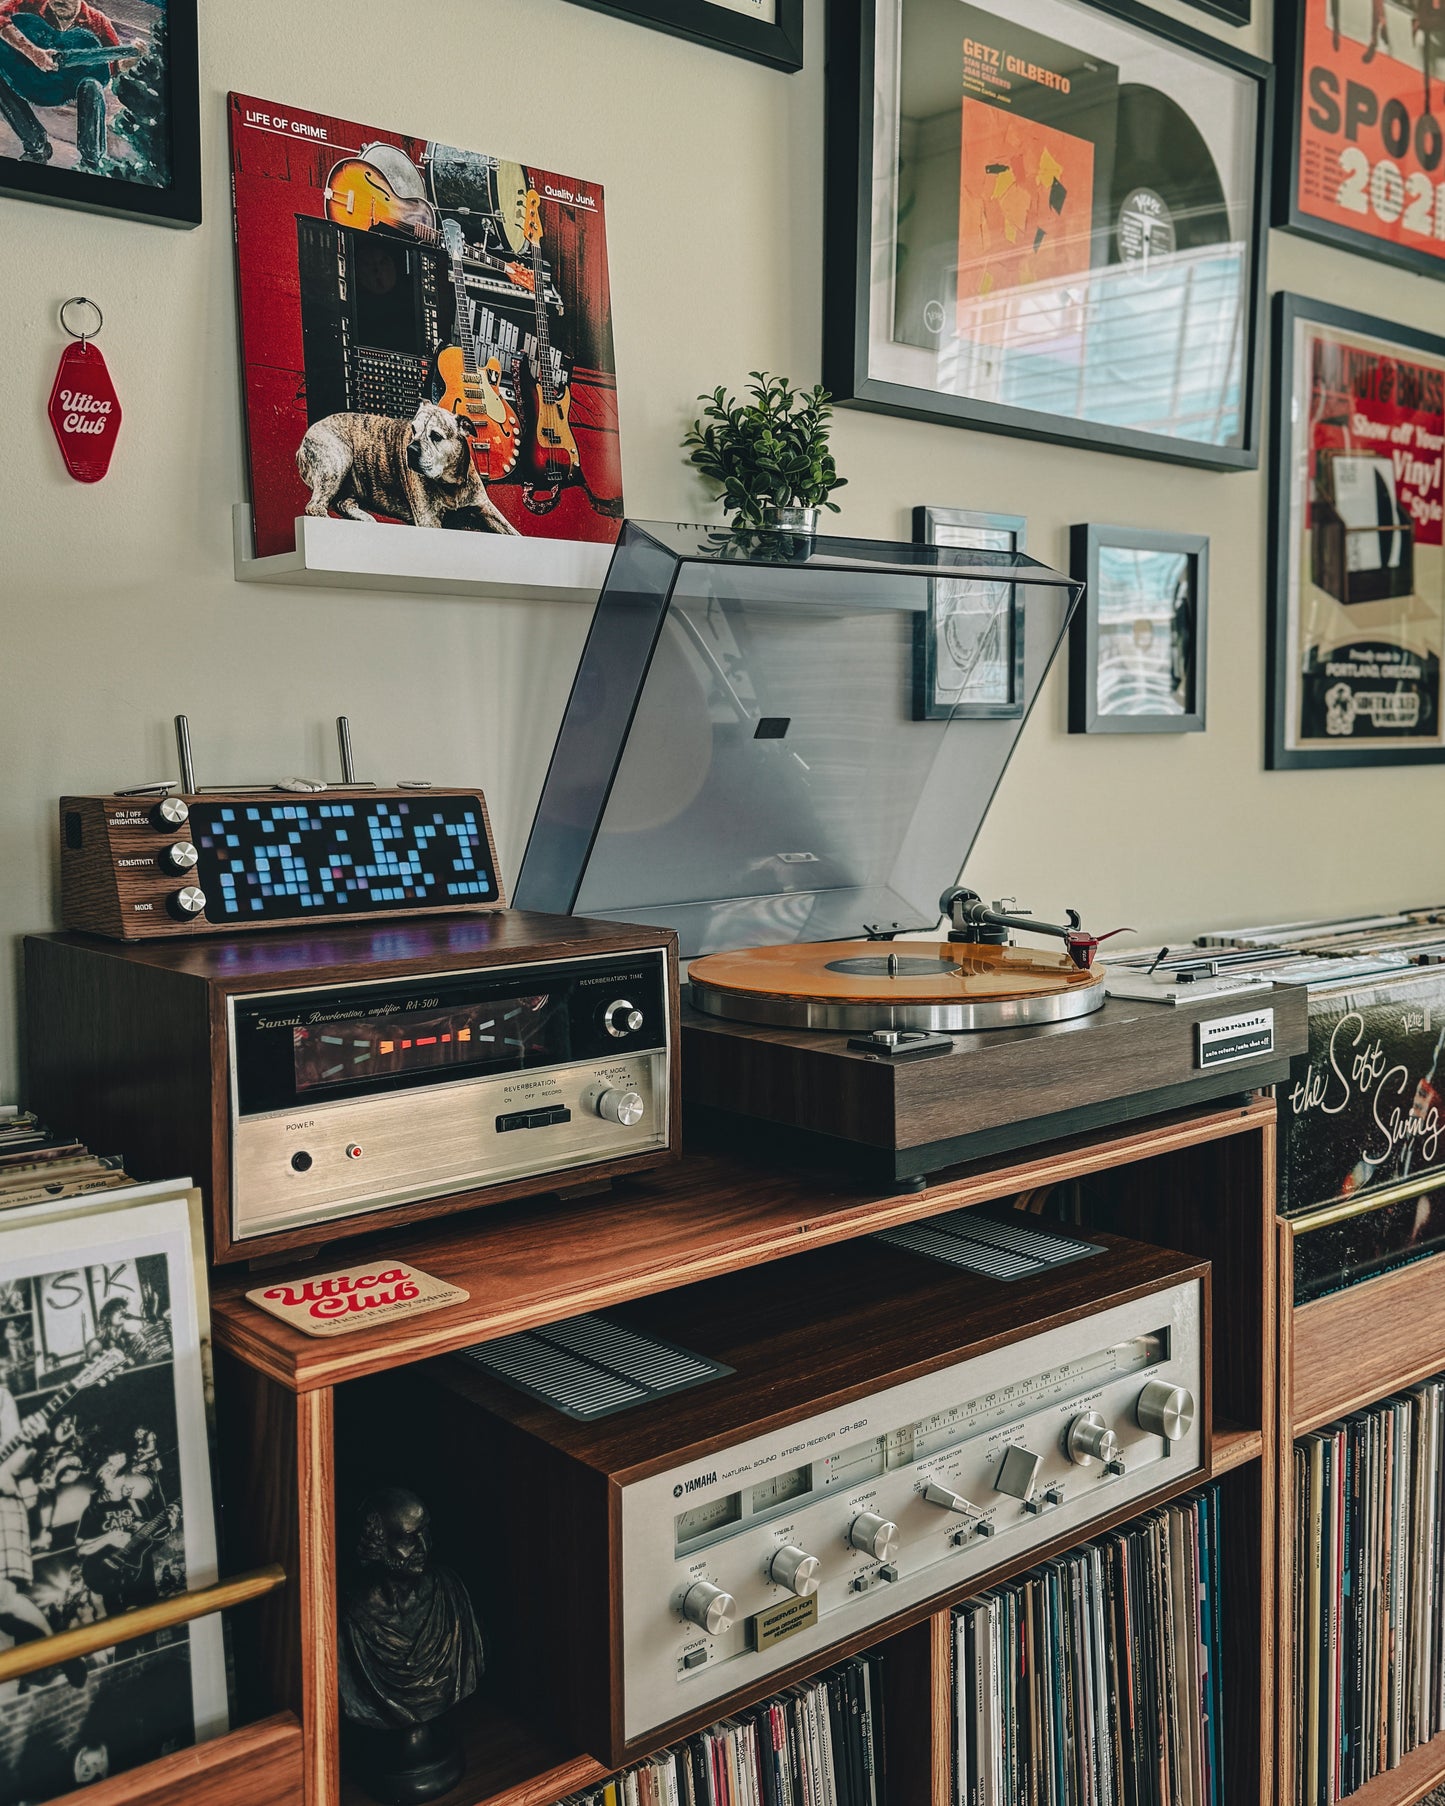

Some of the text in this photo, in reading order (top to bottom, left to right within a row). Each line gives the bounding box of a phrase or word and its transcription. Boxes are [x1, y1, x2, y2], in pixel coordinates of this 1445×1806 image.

[963, 37, 1070, 94] GETZ GILBERTO
[246, 110, 328, 140] LIFE OF GRIME
[1308, 65, 1445, 172] SPOO
[544, 185, 596, 207] Quality Junk
[60, 389, 112, 414] Utica
[63, 412, 107, 435] Club
[1352, 413, 1444, 451] Show off Your
[1392, 449, 1438, 498] Vinyl
[1411, 495, 1443, 527] Style
[109, 818, 149, 826] BRIGHTNESS
[118, 858, 154, 867] SENSITIVITY
[580, 972, 644, 986] REVERBERATION TIME
[256, 998, 439, 1030] Sansui Reverberation amplifier RA-500
[1208, 1018, 1267, 1035] marantz
[609, 1066, 627, 1074] MODE
[1321, 1012, 1386, 1114] Soft
[504, 1079, 557, 1093] REVERBERATION
[1289, 1065, 1329, 1114] the
[286, 1120, 315, 1131] POWER
[1362, 1065, 1445, 1165] Swing
[263, 1268, 411, 1306] Utica
[309, 1281, 420, 1319] Club
[324, 1311, 366, 1327] where
[378, 1300, 412, 1314] really
[1060, 1391, 1103, 1413] VOLUME BALANCE
[930, 1415, 940, 1423] 94
[988, 1423, 1025, 1441] INPUT SELECTOR
[721, 1465, 752, 1480] NATURAL
[753, 1454, 777, 1468] SOUND
[781, 1443, 806, 1457] STEREO
[806, 1432, 836, 1447] RECEIVER
[916, 1449, 962, 1471] REC OUT SELECTOR
[684, 1471, 718, 1494] YAMAHA
[850, 1490, 877, 1505] LOUDNESS
[982, 1507, 997, 1517] FILTER
[773, 1524, 794, 1537] TREBLE
[944, 1519, 970, 1535] LOW FILTER
[689, 1561, 707, 1573] BASS
[763, 1599, 813, 1628] RESERVED FOR
[683, 1638, 707, 1652] POWER
